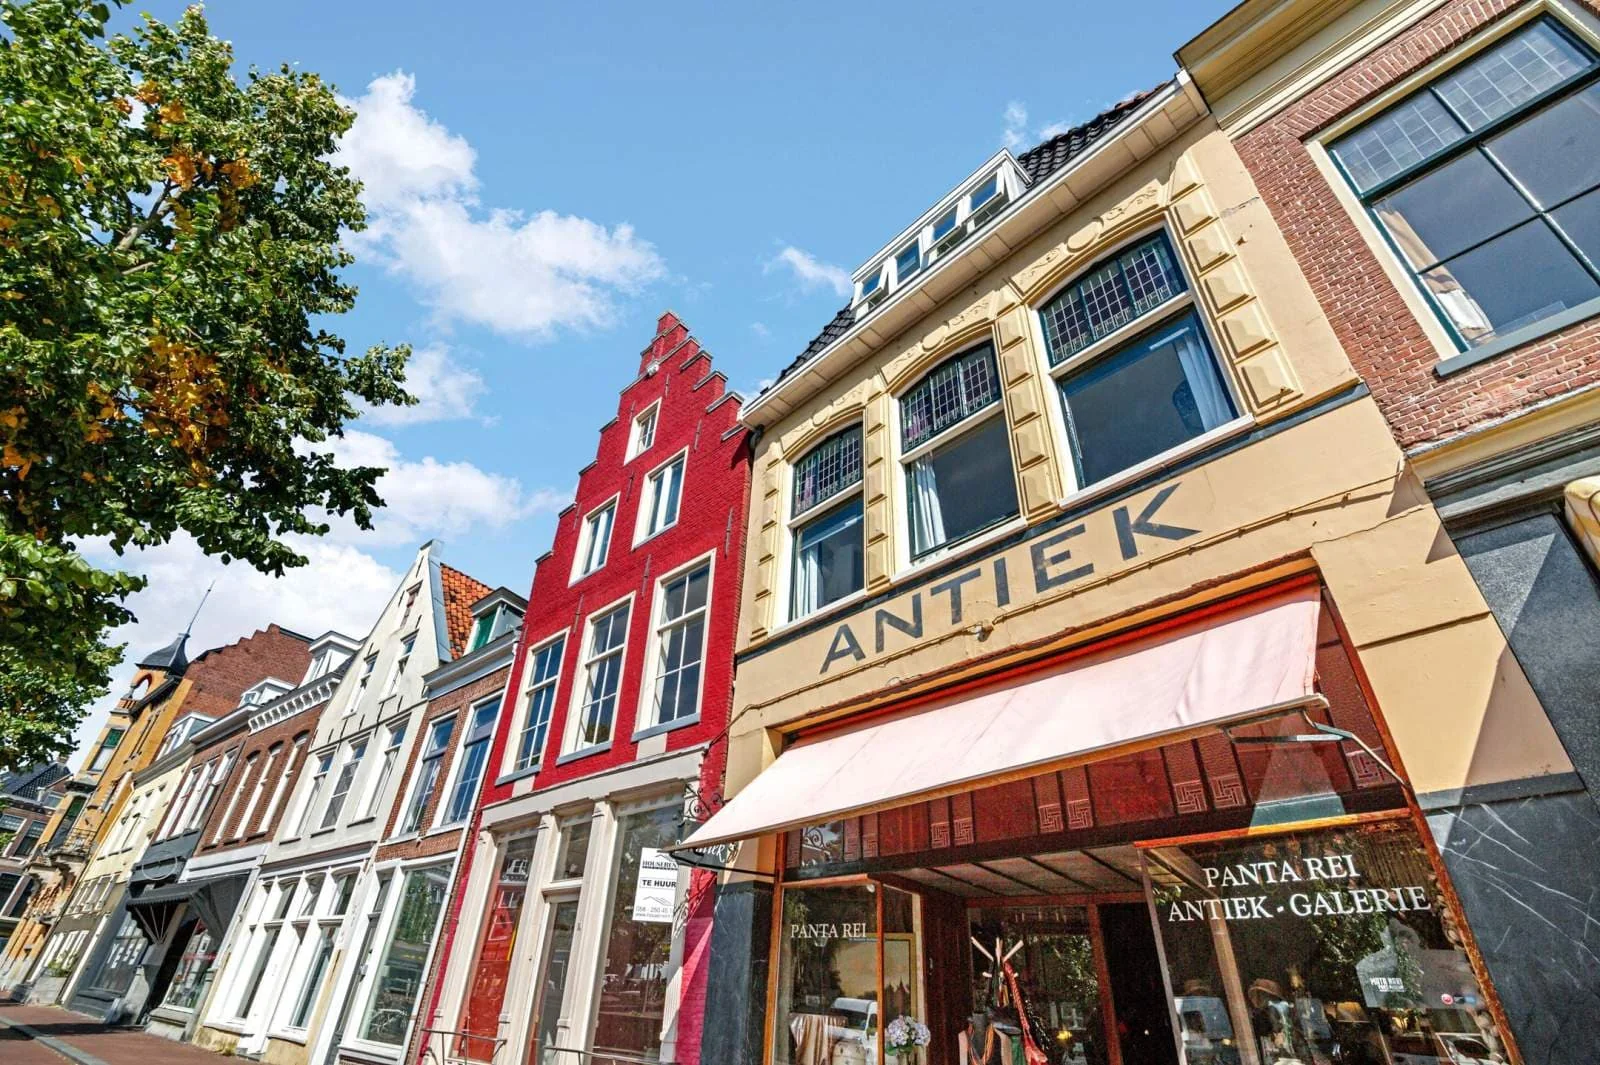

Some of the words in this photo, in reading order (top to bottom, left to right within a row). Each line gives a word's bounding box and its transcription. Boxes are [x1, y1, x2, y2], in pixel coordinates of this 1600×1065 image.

[819, 482, 1202, 674] ANTIEK
[654, 880, 677, 888] HUUR
[1202, 860, 1301, 888] PANTA
[1303, 855, 1361, 881] REI
[1169, 896, 1274, 922] ANTIEK
[1289, 886, 1432, 917] GALERIE
[791, 923, 839, 939] PANTA
[842, 922, 866, 938] REI
